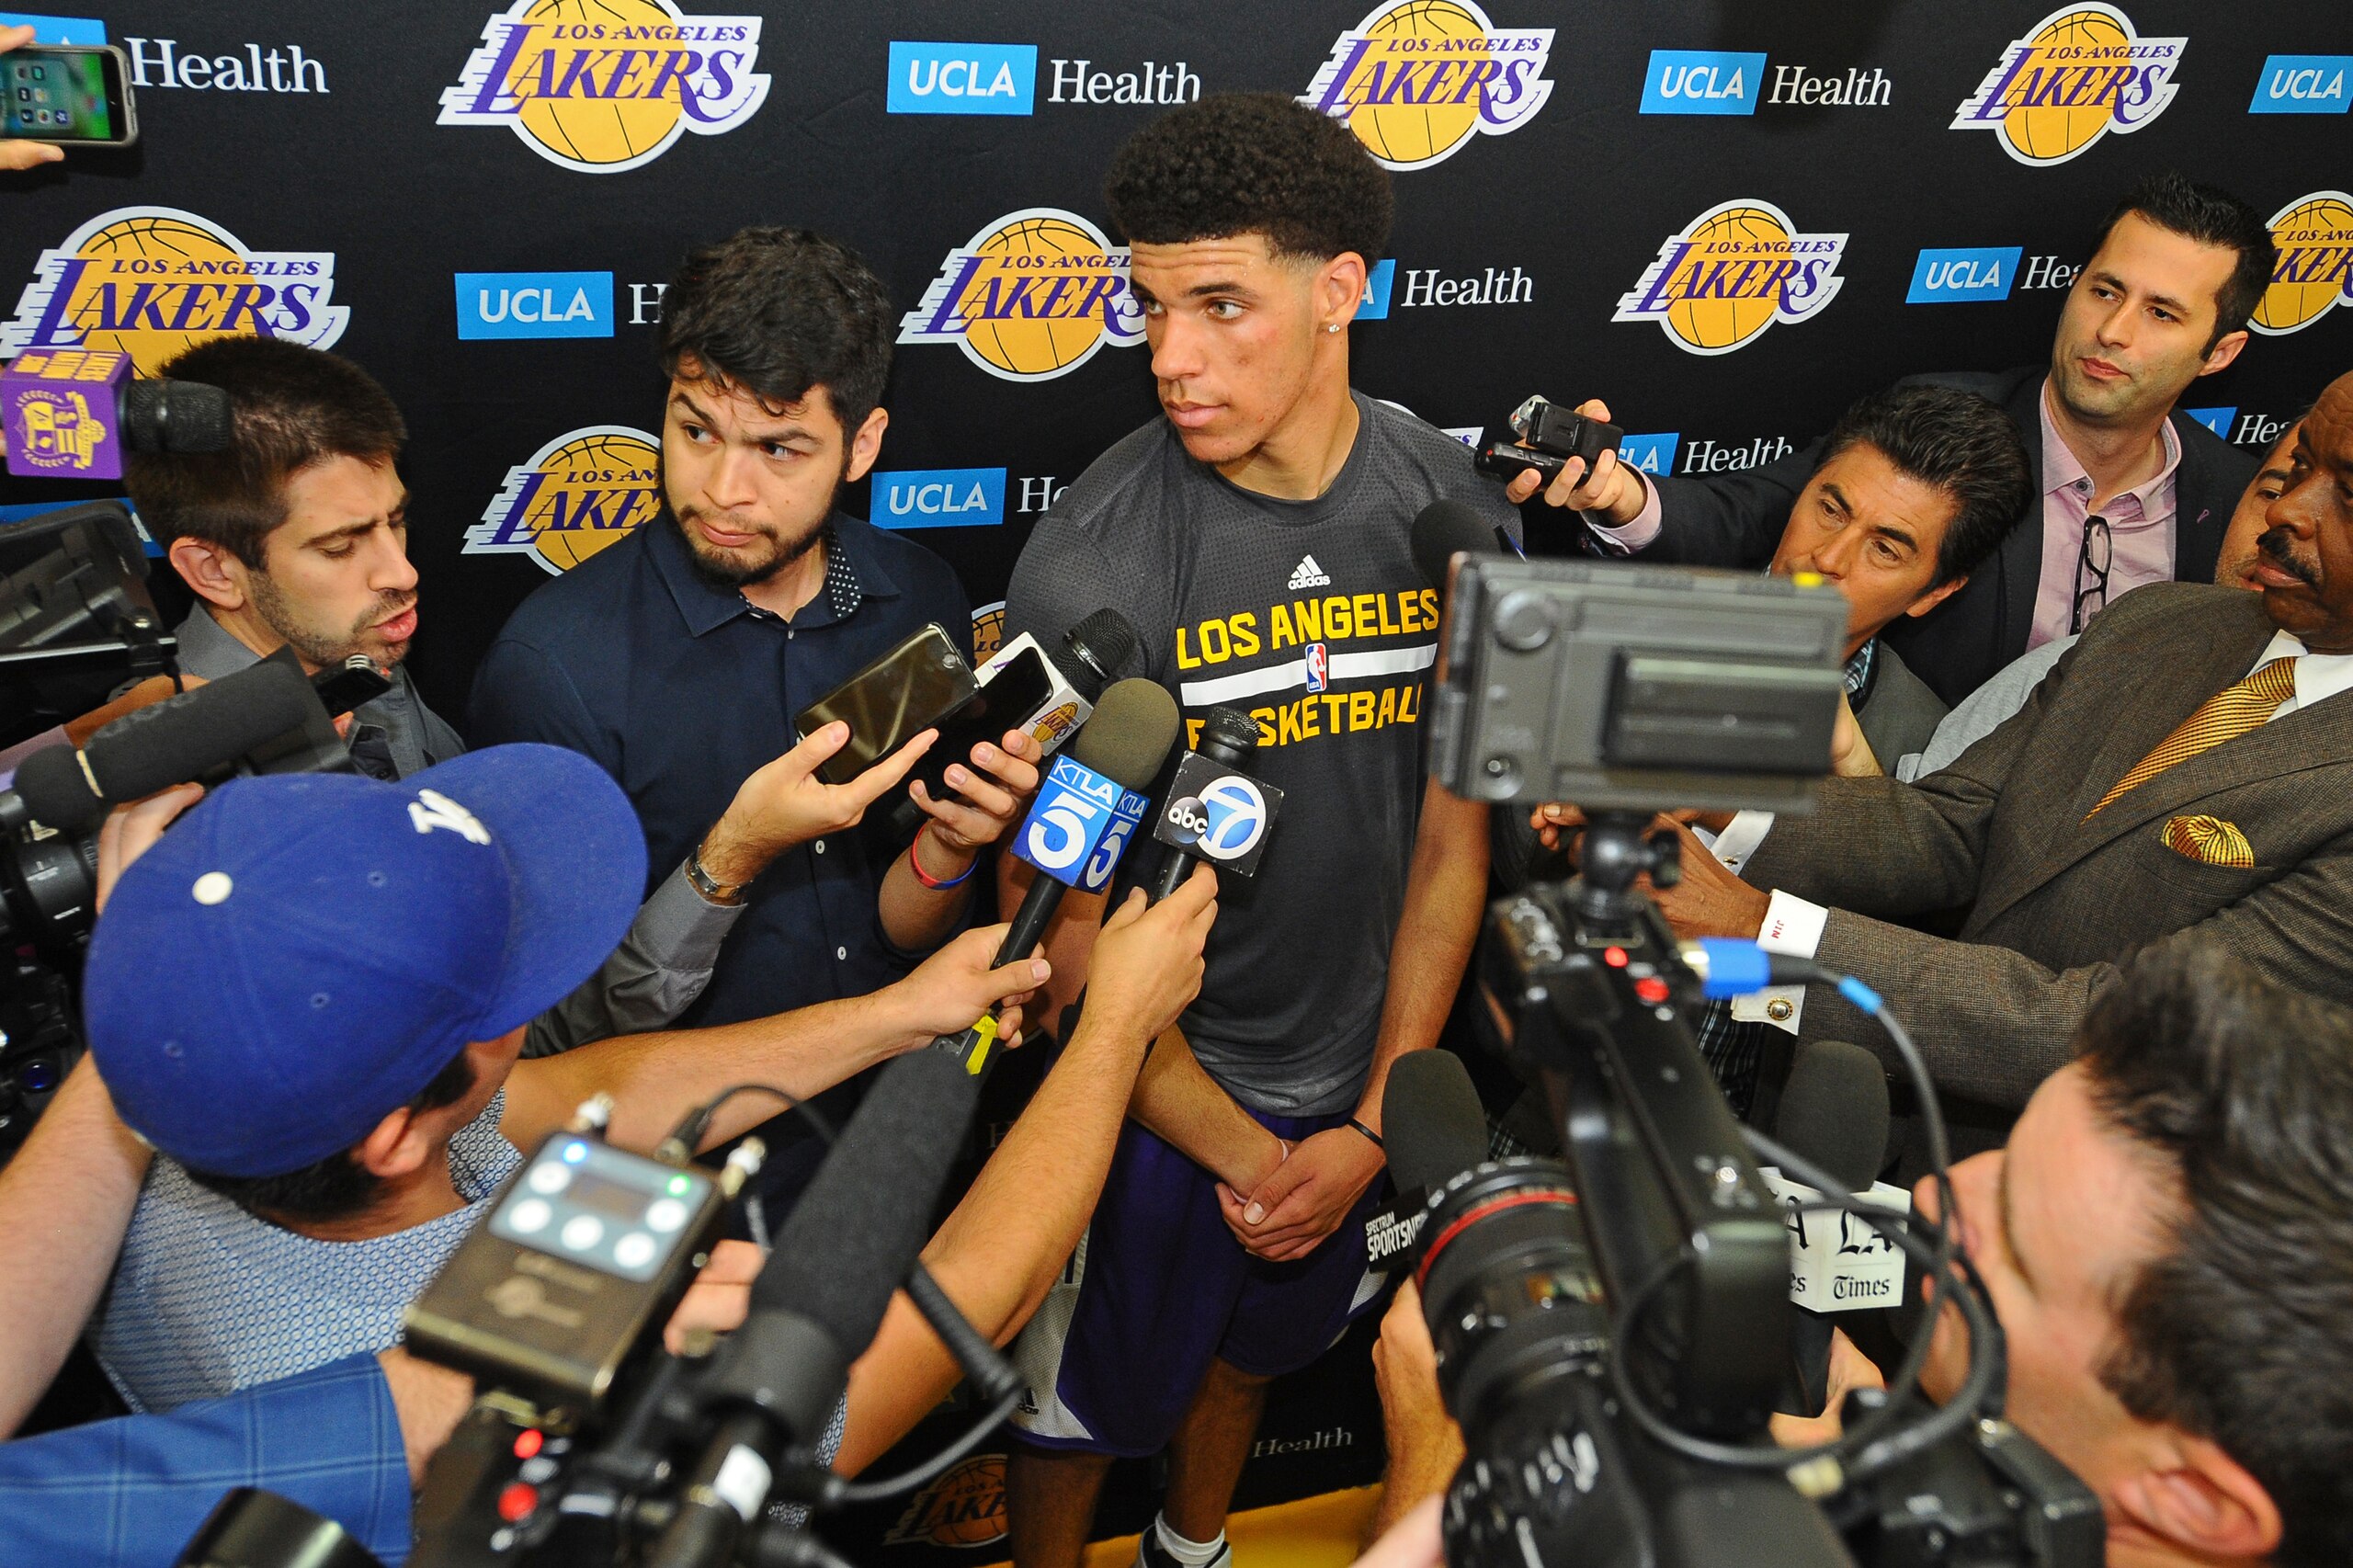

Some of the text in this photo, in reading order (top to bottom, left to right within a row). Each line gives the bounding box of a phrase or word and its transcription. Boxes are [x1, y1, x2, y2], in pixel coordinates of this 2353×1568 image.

[551, 24, 748, 41] LOS ANGELES
[1386, 37, 1543, 51] LOS ANGELES
[124, 37, 331, 93] Health
[2045, 44, 2177, 60] LOS ANGELES
[454, 23, 756, 123] LAKERS
[908, 59, 1200, 105] UCLA Health
[1313, 39, 1541, 124] LAKERS
[1659, 65, 1892, 106] UCLA Health
[1964, 47, 2166, 125] LAKERS
[2268, 69, 2345, 100] UCLA
[1704, 240, 1837, 254] LOS ANGELES
[2285, 230, 2320, 242] LOS
[110, 258, 321, 276] LOS ANGELES
[1000, 255, 1047, 268] LOS
[1925, 259, 2000, 290] UCLA
[1401, 267, 1533, 307] Health
[1625, 242, 1833, 315] LAKERS
[14, 257, 335, 347] LAKERS
[479, 287, 596, 324] UCLA
[564, 470, 614, 483] LOS
[889, 481, 988, 516] UCLA
[1288, 574, 1331, 590] adidas
[1176, 611, 1261, 670] LOS
[1270, 587, 1439, 651] ANGELES
[1053, 758, 1113, 805] KTLA
[1118, 791, 1146, 817] KTLA
[1167, 806, 1208, 835] abc
[1201, 780, 1262, 856] 7
[1028, 791, 1098, 869] 5
[1086, 820, 1132, 888] 5
[1365, 1210, 1396, 1236] SPECTRUM
[1833, 1274, 1891, 1300] Times
[1252, 1426, 1352, 1458] Health
